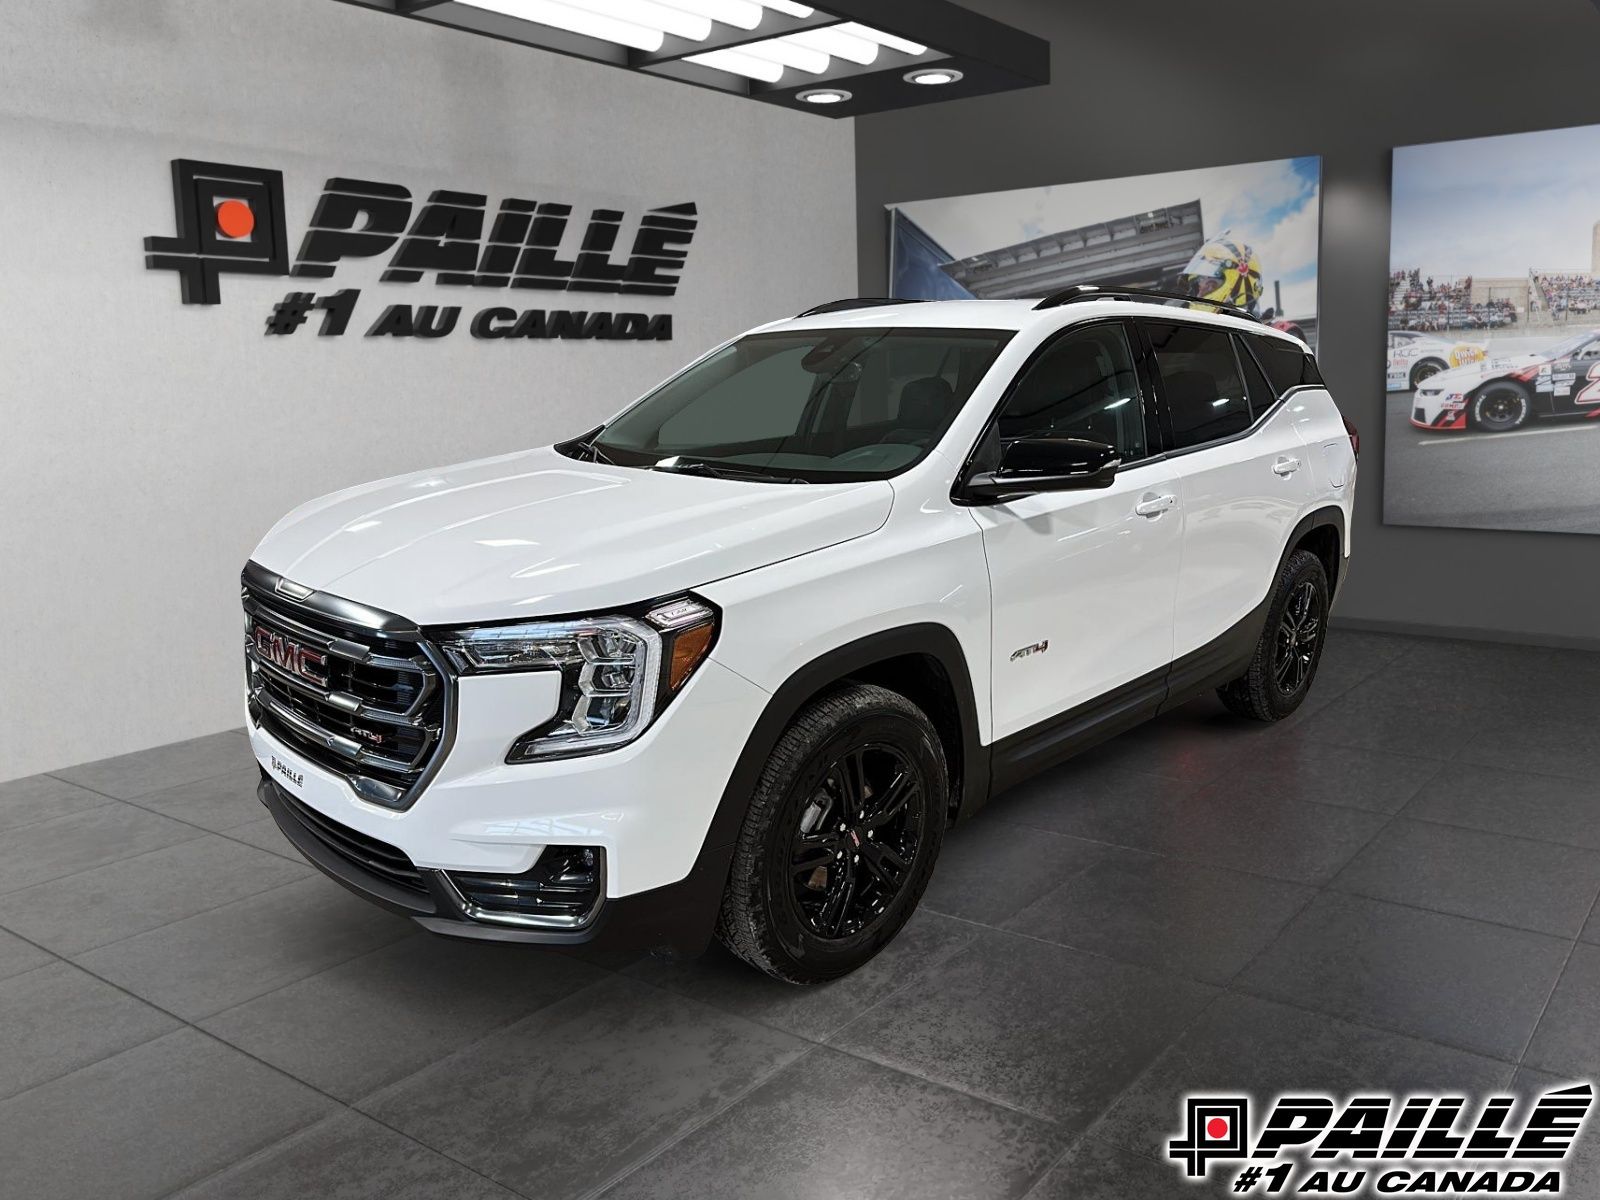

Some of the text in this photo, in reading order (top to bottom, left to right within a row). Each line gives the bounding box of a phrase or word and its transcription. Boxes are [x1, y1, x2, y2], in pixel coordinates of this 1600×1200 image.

[290, 177, 697, 296] PAILLÉ
[264, 288, 673, 341] #1 AU CANADA
[254, 626, 328, 687] GMC
